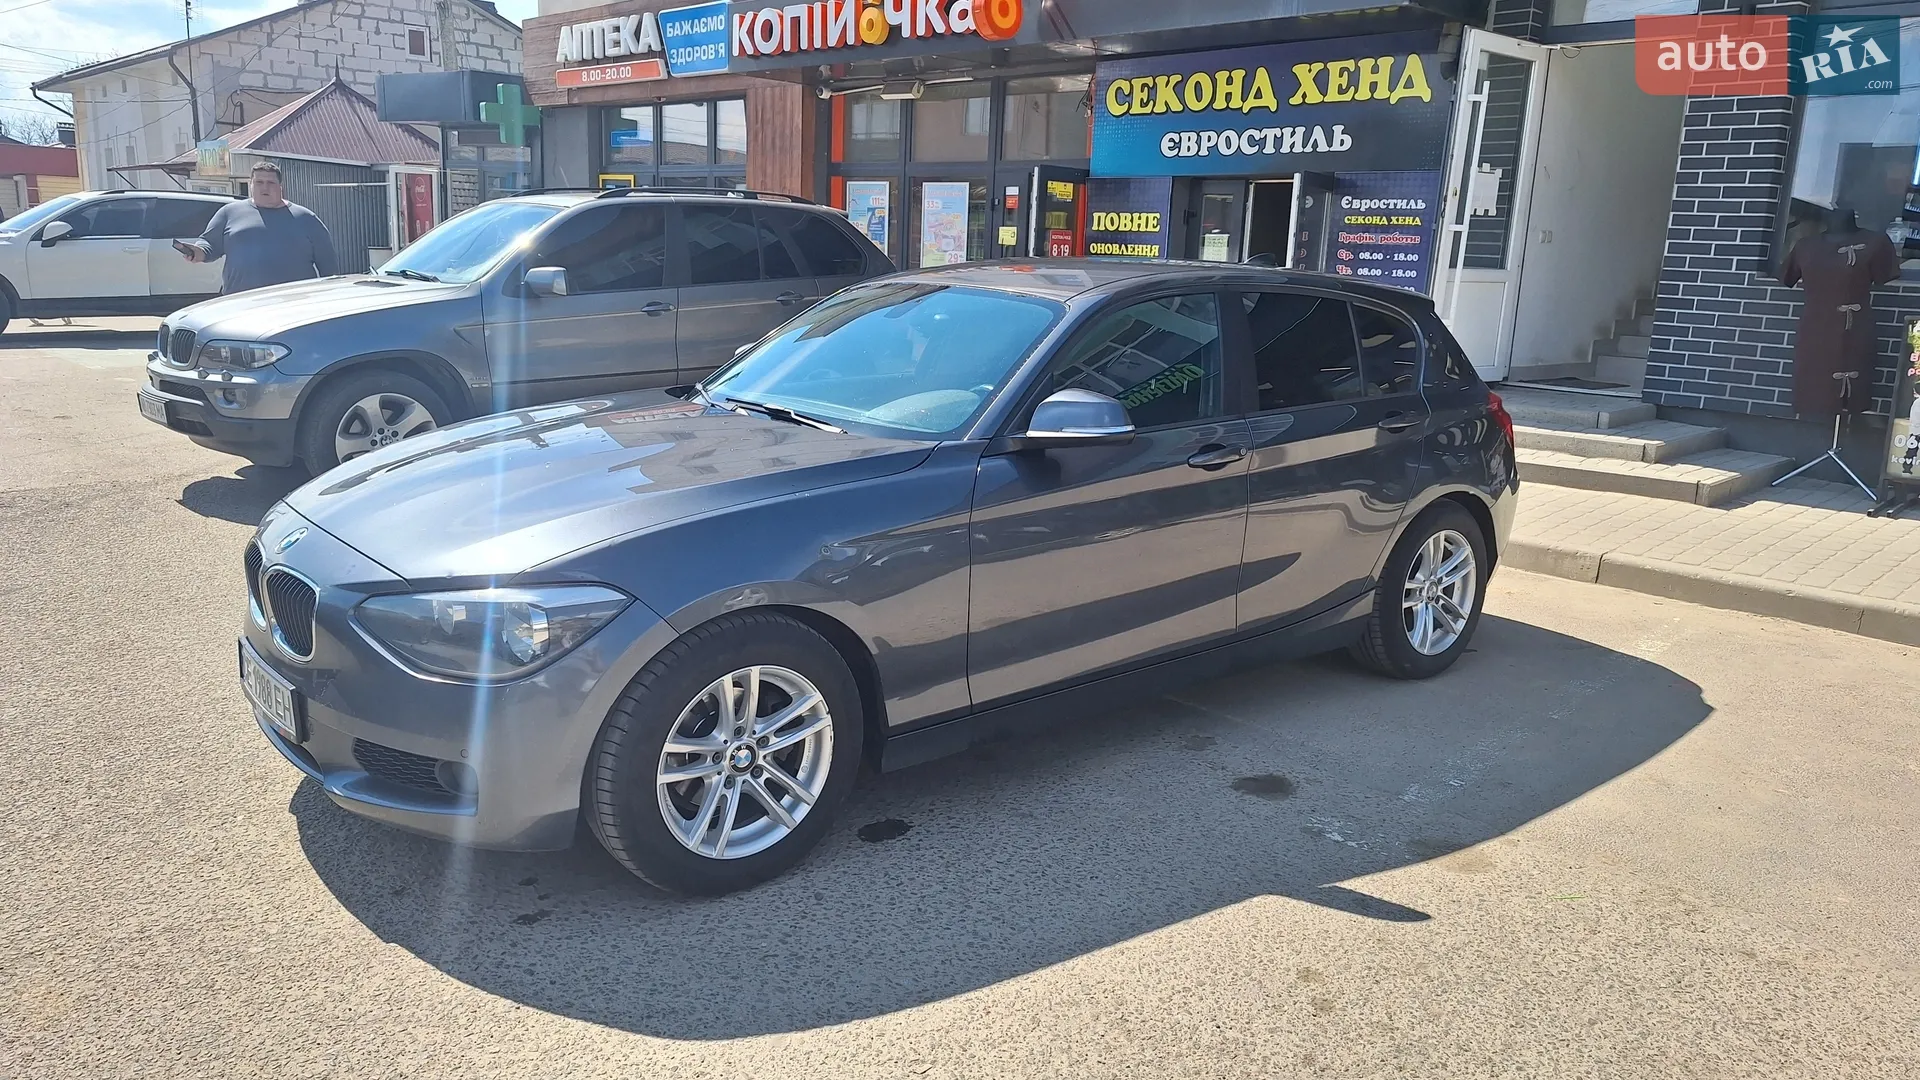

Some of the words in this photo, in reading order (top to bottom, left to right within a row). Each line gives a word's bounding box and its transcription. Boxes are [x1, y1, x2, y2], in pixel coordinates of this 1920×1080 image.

[666, 15, 726, 38] БАЖАЄМО
[556, 12, 661, 62] АПТЕКА
[670, 43, 726, 66] ЗДОРОВ'Я
[581, 66, 632, 82] 8.00-20.00
[1106, 65, 1278, 118] СЕКОНД
[1289, 53, 1433, 106] ХЕНД
[1159, 124, 1353, 158] ЄВРОСТИЛЬ
[1341, 196, 1426, 211] Євростиль
[1092, 212, 1160, 232] ПОВНЕ
[1344, 215, 1388, 225] СЕКОНД
[1390, 215, 1421, 225] ХЕНД
[1089, 242, 1159, 257] ОНОВЛЕННЯ
[1358, 251, 1384, 260] 08.00
[1393, 252, 1419, 261] 18.00
[1357, 267, 1382, 276] 08.00
[1391, 268, 1417, 278] 18.00
[1894, 434, 1920, 449] 06
